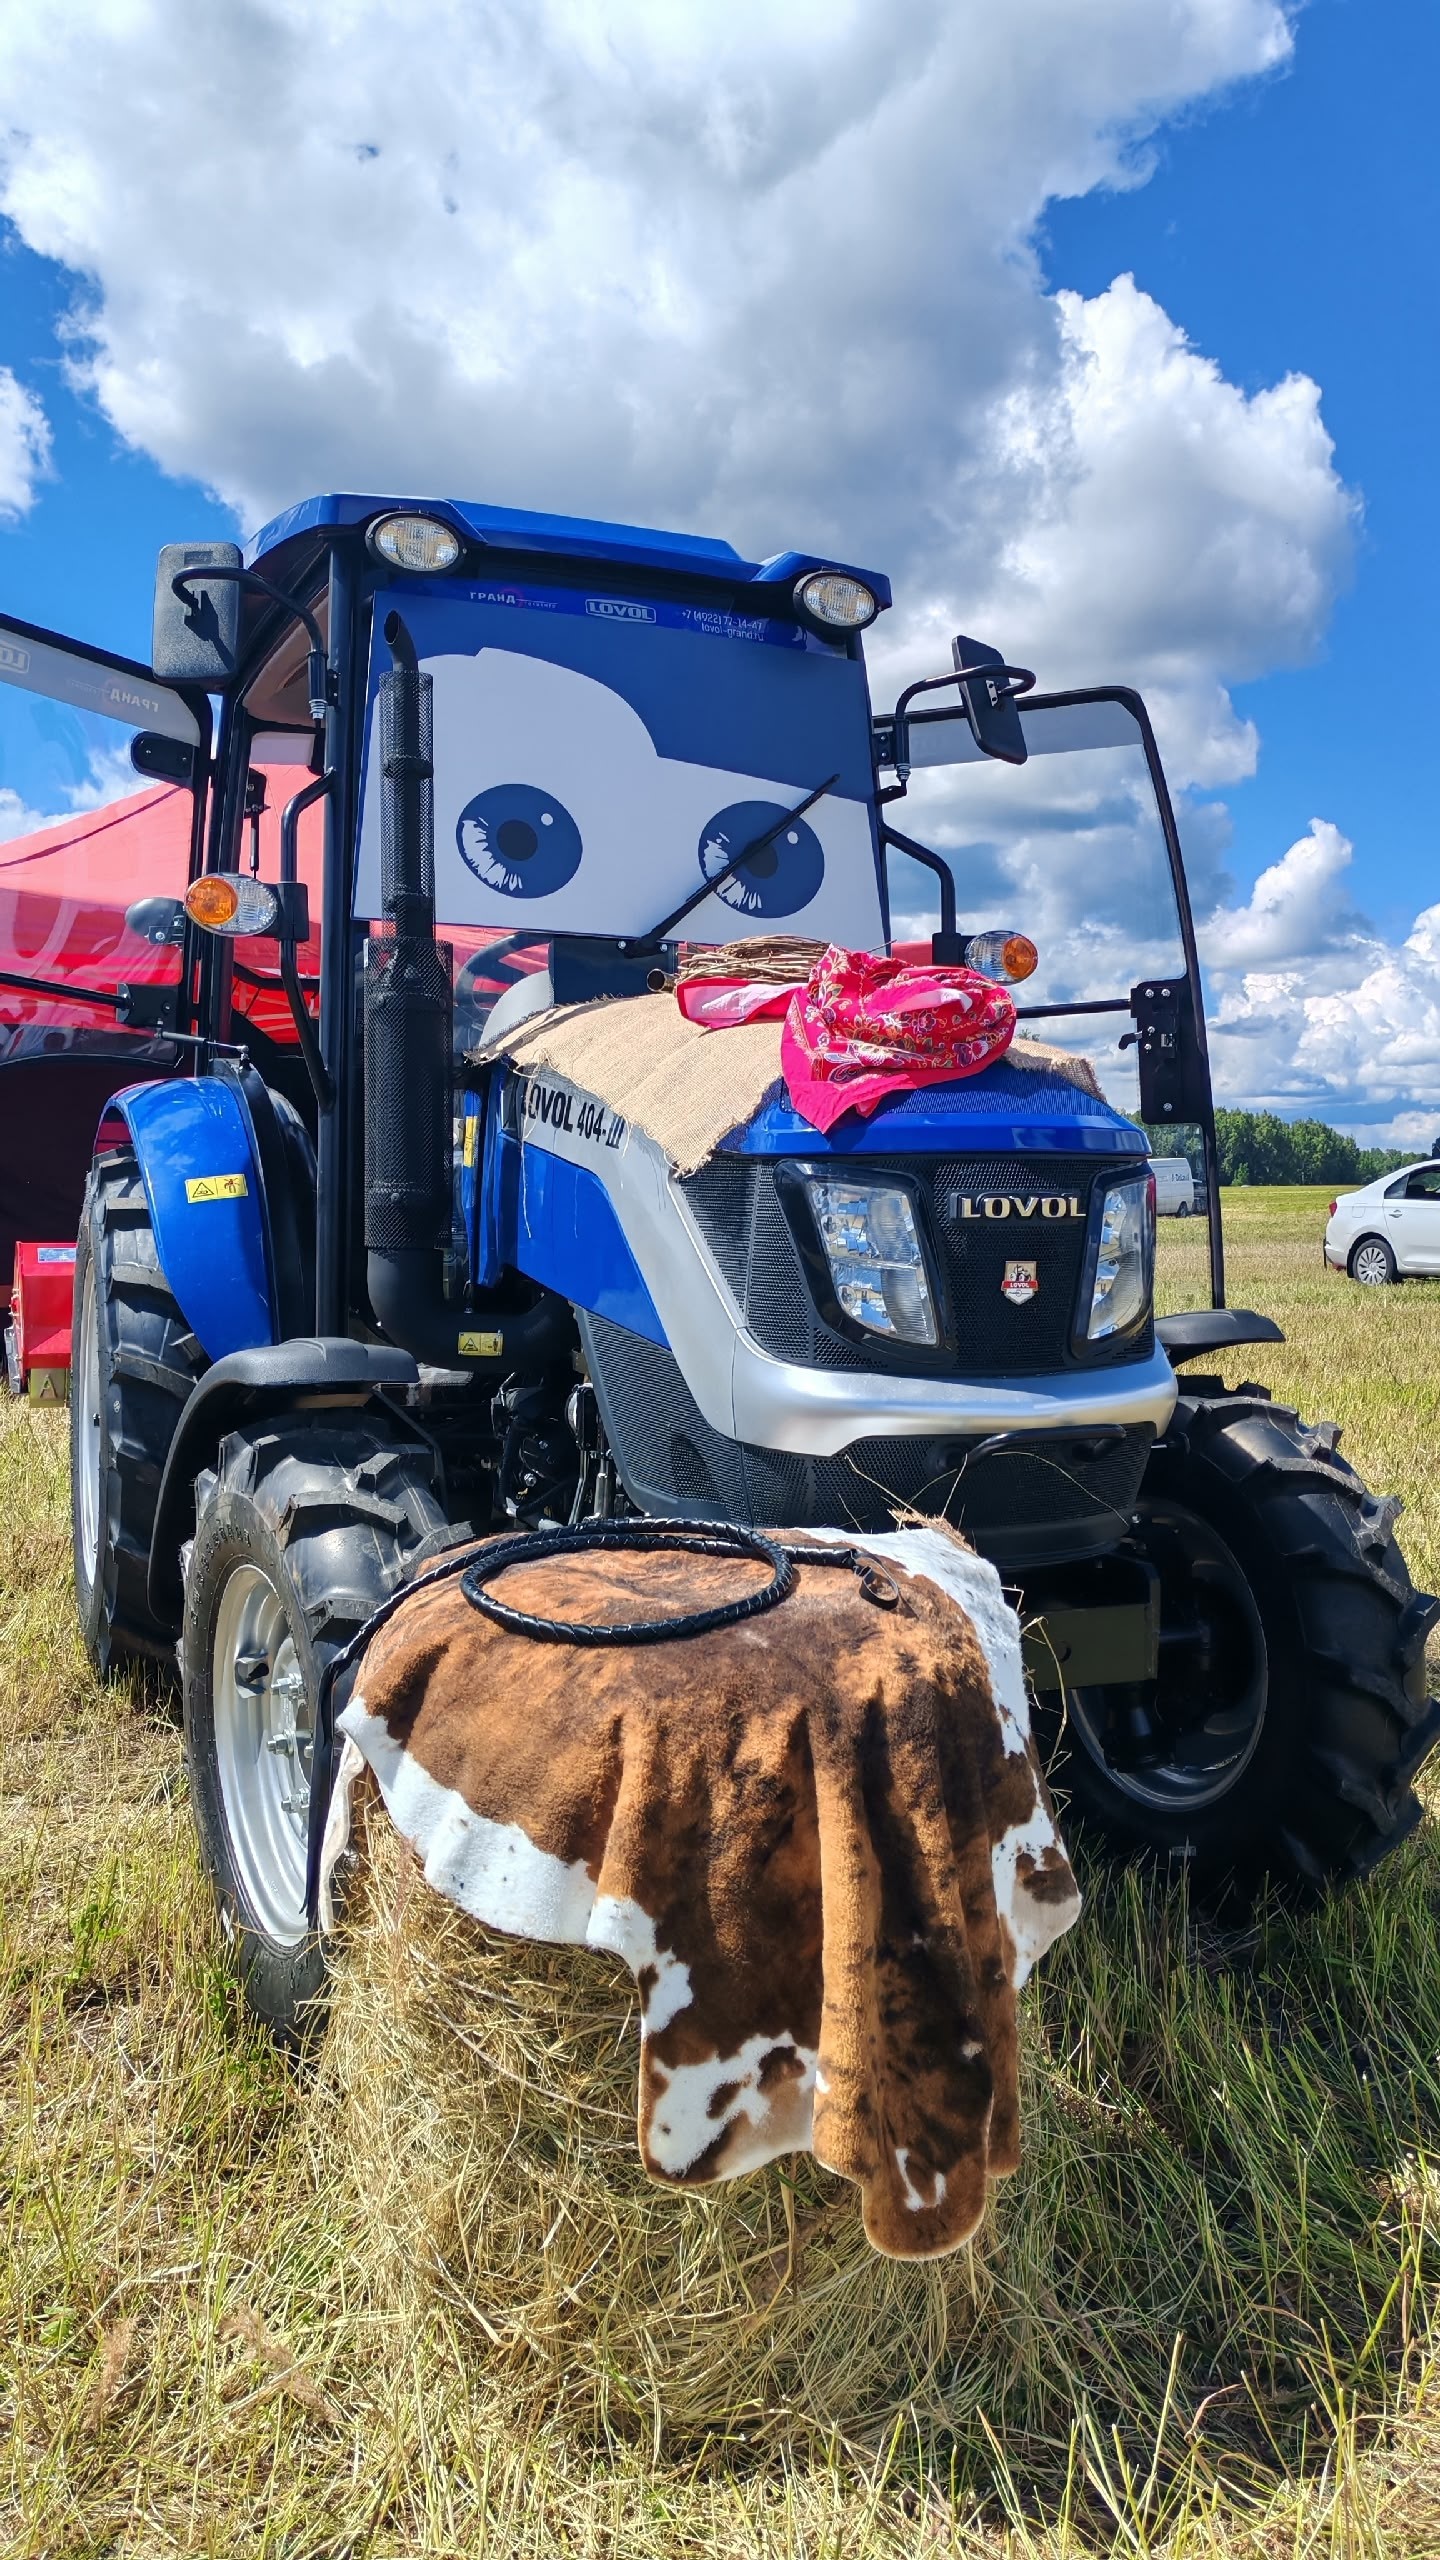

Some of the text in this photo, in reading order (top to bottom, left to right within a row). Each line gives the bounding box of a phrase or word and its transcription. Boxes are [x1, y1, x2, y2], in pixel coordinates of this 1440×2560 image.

[470, 591, 516, 605] ГРАНД
[589, 602, 653, 620] LOVOL
[682, 609, 692, 619] +7
[701, 622, 764, 641] lovol-grand.ru
[961, 1196, 1087, 1219] LOVOL
